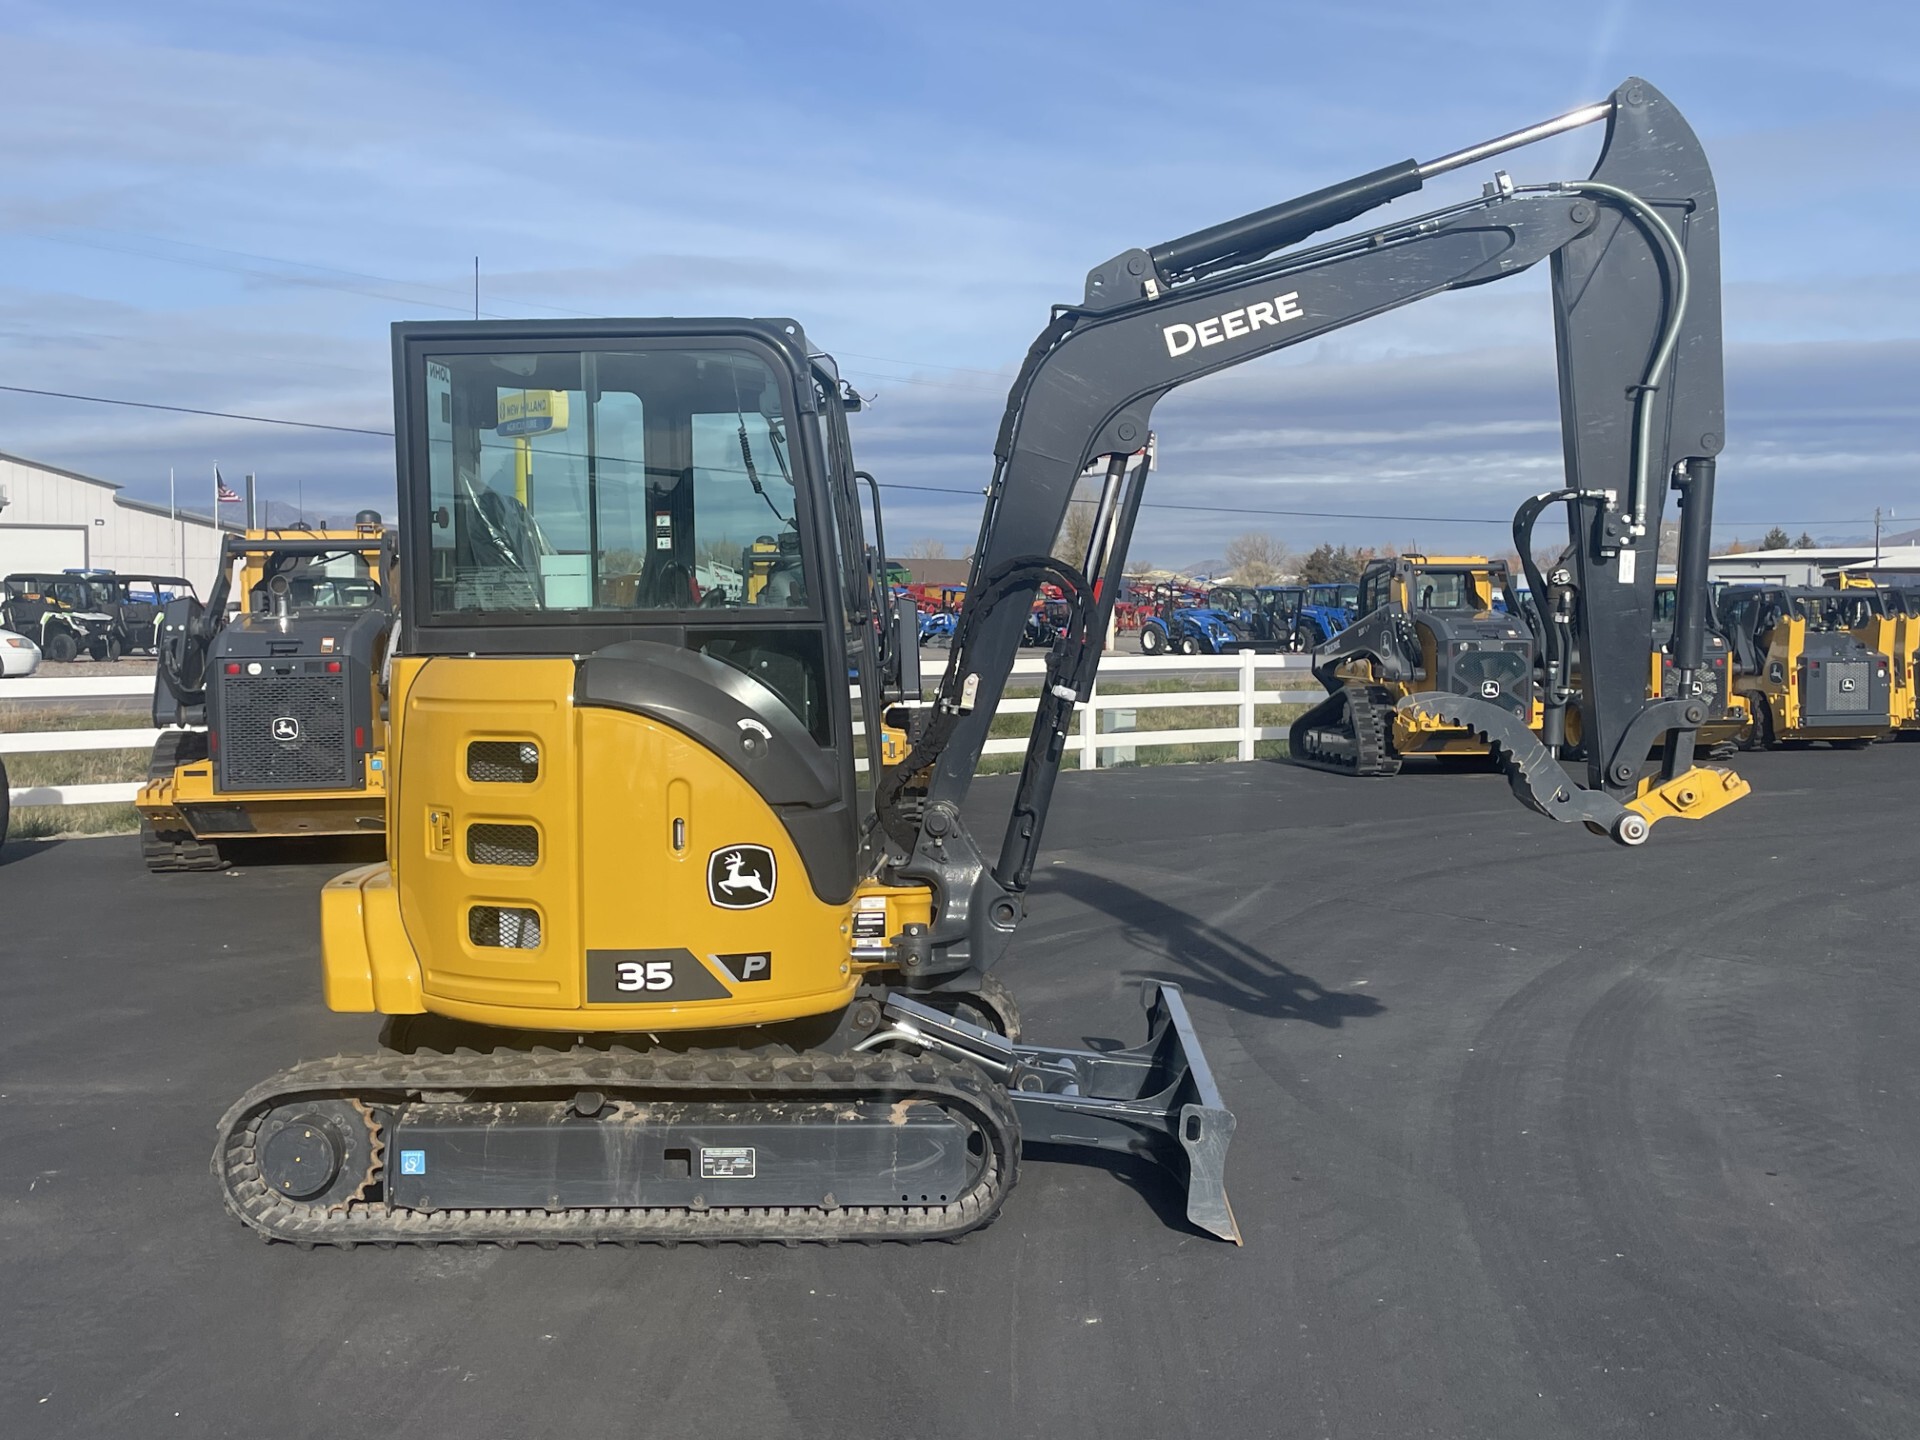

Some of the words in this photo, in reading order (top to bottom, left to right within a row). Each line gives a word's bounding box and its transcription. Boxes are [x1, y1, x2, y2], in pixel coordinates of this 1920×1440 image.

[1163, 291, 1304, 358] DEERE
[507, 404, 519, 415] NEW
[617, 962, 673, 991] 35
[742, 956, 767, 979] P
